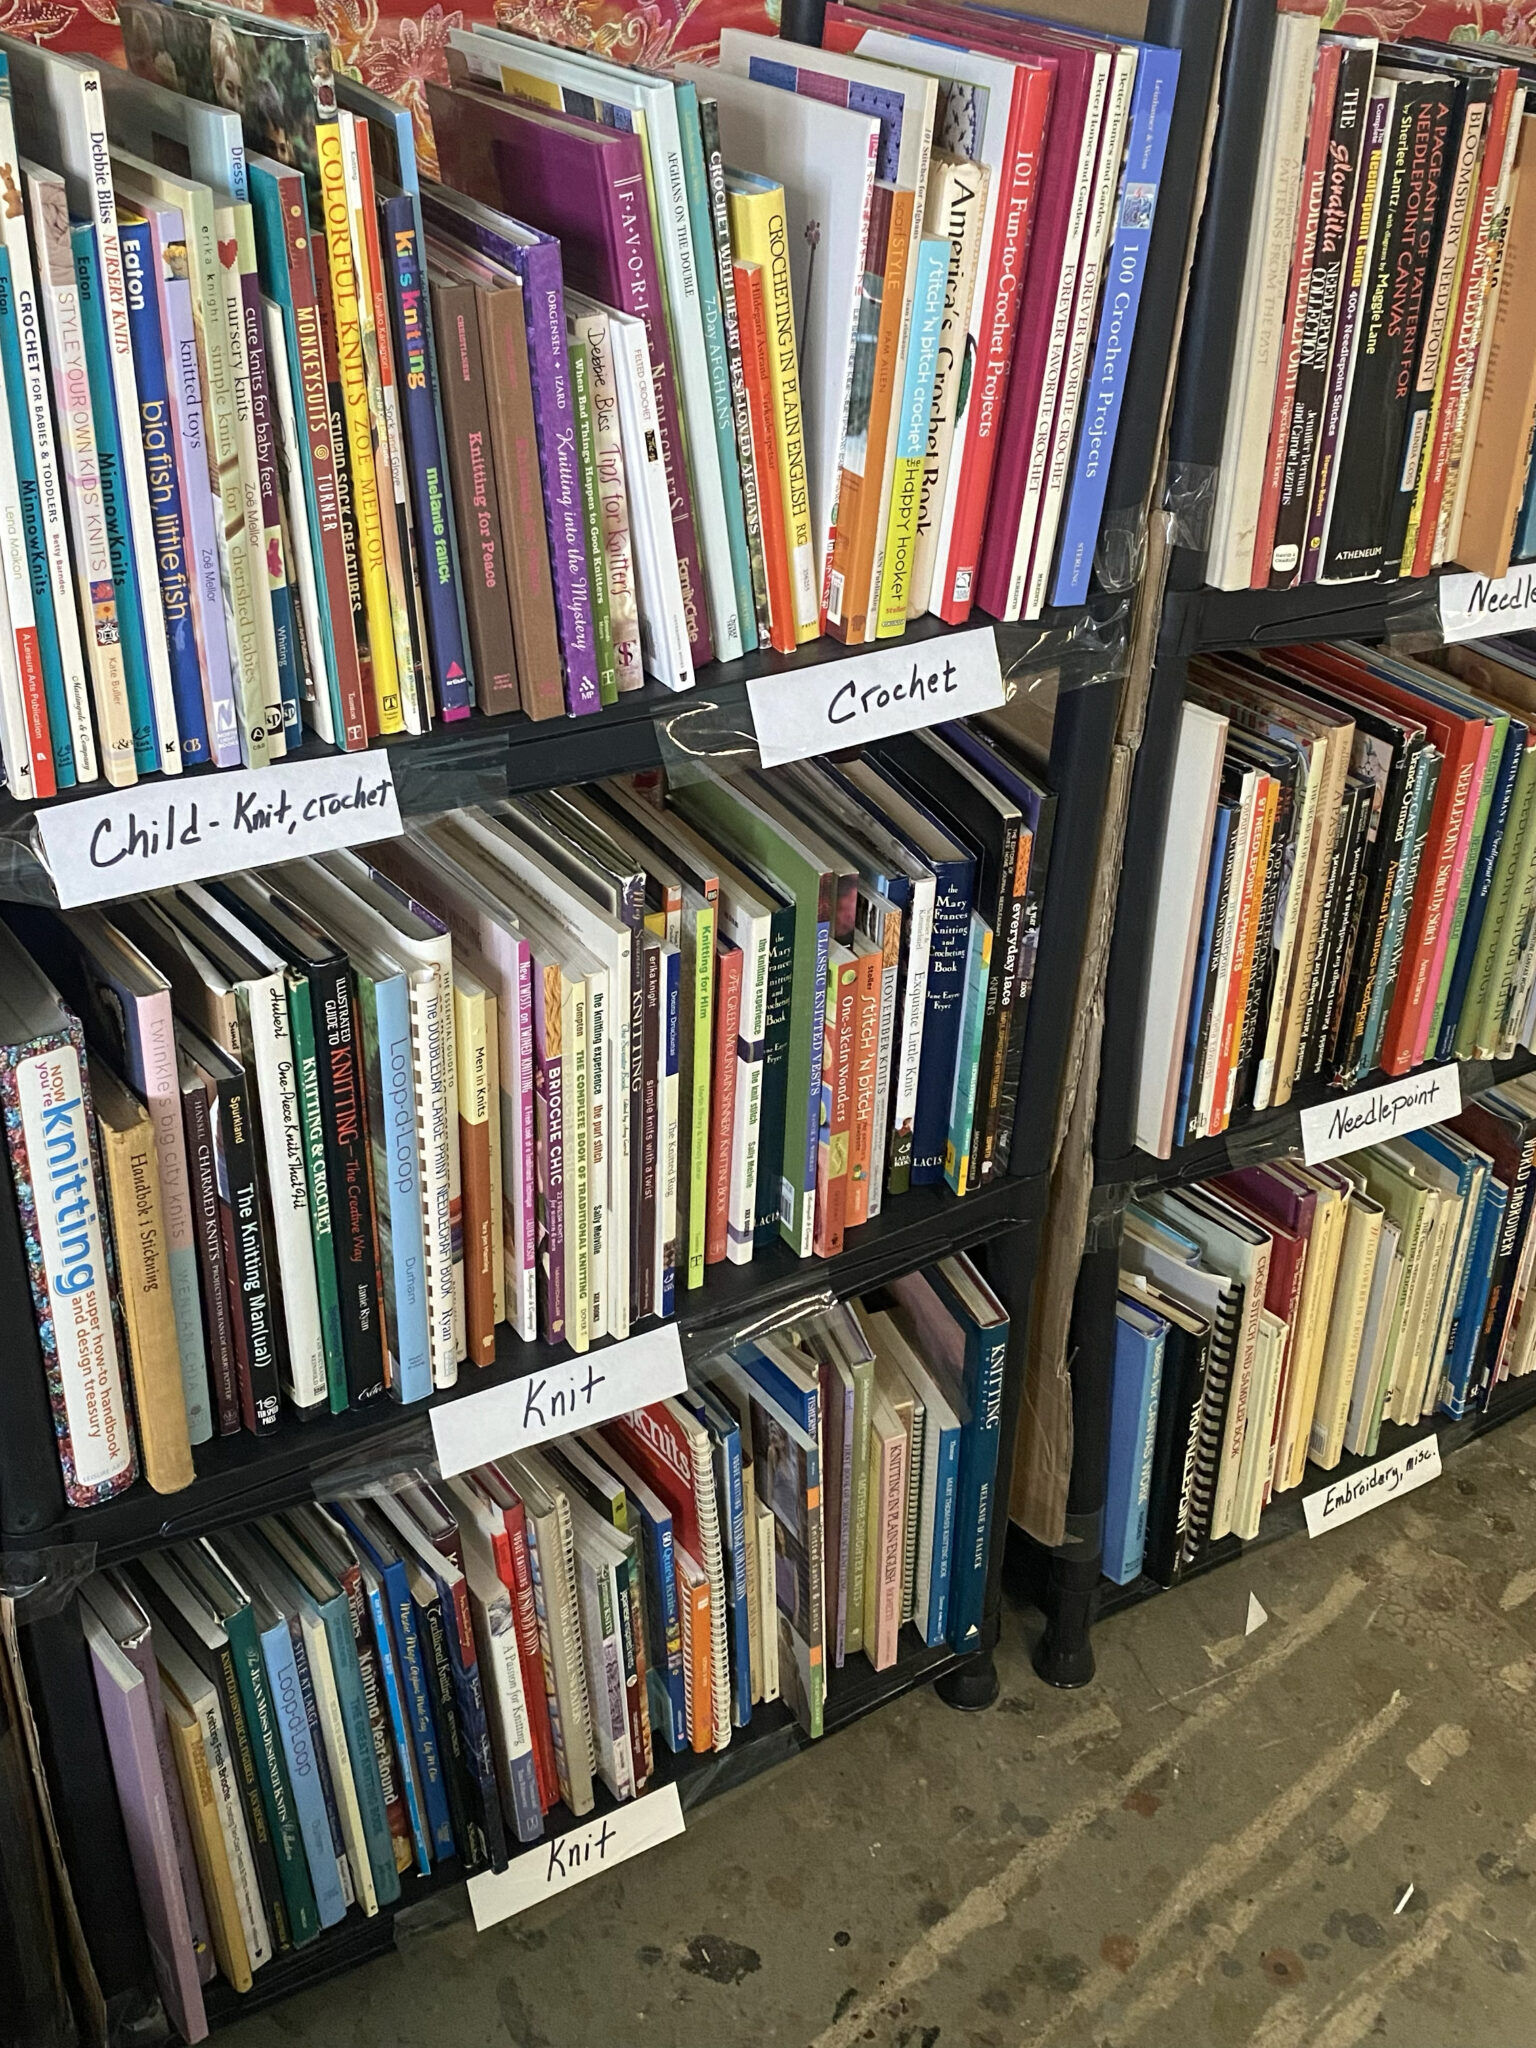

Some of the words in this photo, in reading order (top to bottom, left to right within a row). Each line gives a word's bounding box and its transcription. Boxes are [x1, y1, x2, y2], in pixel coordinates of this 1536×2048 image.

[1340, 88, 1359, 129] THE
[1436, 102, 1449, 119] A
[90, 131, 108, 185] Debbie
[230, 147, 243, 189] Dress
[1012, 150, 1035, 188] 101
[1402, 104, 1434, 248] NEEDLEPOINT
[1423, 126, 1447, 224] PAGEANT
[1445, 111, 1482, 252] BLOOMSBURY
[97, 189, 112, 225] Bliss
[1322, 140, 1354, 253] Glorafilia
[1359, 150, 1381, 240] Needlepoint
[102, 234, 125, 310] NURSERY
[989, 196, 1030, 354] Fun-to-Crochet
[1118, 243, 1140, 285] 100
[1352, 245, 1368, 287] Guide
[1416, 230, 1430, 261] OF
[77, 256, 92, 301] Eaton
[120, 239, 146, 312] Eaton
[768, 214, 793, 345] CROCHETING
[1053, 264, 1075, 339] FOREVER
[1075, 261, 1097, 337] FOREVER
[1371, 273, 1391, 325] Maggie
[1386, 254, 1413, 338] CANVAS
[58, 291, 78, 352] STYLE
[111, 310, 130, 355] KNITS
[226, 297, 242, 371] nursery
[244, 307, 258, 343] cute
[703, 295, 717, 342] 7-Day
[1101, 289, 1131, 385] Crochet
[1300, 267, 1327, 367] COLLECTION
[1313, 261, 1341, 373] NEEDLEPOINT
[1403, 267, 1427, 354] PATTERN
[1421, 257, 1456, 386] NEEDLEPOINT
[249, 347, 265, 391] knits
[321, 136, 353, 308] COLORFUL
[340, 319, 367, 407] KNITS
[360, 477, 384, 573] MELLOR
[586, 327, 607, 387] Debbie
[780, 349, 796, 373] IN
[1366, 326, 1379, 357] Lane
[65, 352, 88, 408] YOUR
[179, 336, 204, 407] knitted
[233, 374, 249, 422] knits
[708, 344, 731, 431] AFGHANS
[978, 360, 1007, 441] Projects
[1040, 343, 1063, 418] FAVORITE
[1063, 341, 1085, 416] FAVORITE
[1394, 358, 1413, 400] FOR
[72, 411, 91, 453] OWN
[188, 410, 204, 450] toys
[254, 393, 269, 420] for
[297, 307, 328, 433] MONKEYSUITS
[317, 474, 339, 533] TURNER
[594, 396, 615, 433] Bliss
[783, 378, 803, 437] PLAIN
[1085, 390, 1115, 478] Projects
[256, 422, 275, 463] baby
[468, 431, 487, 507] Knitting
[599, 443, 624, 485] Tips
[907, 457, 921, 469] the
[1028, 420, 1050, 492] CROCHET
[1050, 418, 1072, 490] CROCHET
[79, 456, 100, 505] KIDS'
[259, 460, 274, 498] feet
[426, 466, 444, 536] melanie
[604, 492, 625, 522] for
[788, 444, 810, 517] ENGLISH
[897, 469, 920, 532] Happy
[21, 479, 47, 597] MinnowKnits
[86, 513, 107, 576] KNITS
[97, 452, 127, 587] MinnowKnits
[476, 511, 491, 535] for
[201, 549, 213, 570] Zoë
[434, 538, 450, 585] falick
[482, 541, 497, 592] Peace
[891, 536, 913, 603] Hooker
[1335, 546, 1382, 561] ATHENEUM
[203, 571, 217, 604] Mellor
[276, 625, 288, 668] Whiting
[827, 660, 958, 724] Crochet
[90, 803, 201, 867] Child
[233, 790, 297, 835] Knit,
[303, 776, 393, 821] crochet
[1245, 815, 1265, 898] NEEDLEPOINT
[936, 896, 968, 912] Mary
[815, 929, 830, 983] CLASSIC
[1234, 900, 1252, 973] ALPHABETS
[934, 962, 958, 973] Book
[335, 976, 352, 1047] ILLUSTRATED
[813, 984, 828, 1049] KNITTED
[840, 994, 855, 1062] One-Skein
[35, 1062, 53, 1107] you're
[51, 1065, 67, 1103] NOW
[302, 1056, 323, 1144] KNITTING
[331, 1046, 359, 1147] KNITTING
[810, 1052, 824, 1097] VESTS
[837, 1063, 851, 1127] Wonders
[230, 1096, 246, 1148] Spurkland
[547, 1066, 563, 1144] BRIOCHE
[1328, 1080, 1440, 1140] Needlepoint
[197, 1144, 217, 1220] CHARMED
[310, 1147, 324, 1160] &
[549, 1147, 564, 1191] CHIC
[913, 1156, 943, 1168] LACIS
[43, 1097, 98, 1297] knitting
[237, 1182, 255, 1222] The
[312, 1161, 332, 1238] CROCHET
[349, 1184, 364, 1234] Creative
[1499, 1183, 1531, 1259] EMBROIDERY
[205, 1223, 221, 1266] KNITS
[242, 1224, 264, 1296] Knitting
[351, 1235, 369, 1263] Way
[85, 1289, 101, 1332] super
[403, 1257, 418, 1306] Durham
[71, 1296, 88, 1329] and
[249, 1294, 273, 1369] Man(ual)
[441, 1308, 454, 1343] Ryan
[76, 1329, 94, 1378] design
[92, 1334, 108, 1386] how-to
[83, 1379, 103, 1438] treasury
[523, 1364, 606, 1428] Knit
[986, 1342, 1006, 1430] KNITTING
[100, 1386, 121, 1461] handbook
[250, 1668, 266, 1699] JEAN
[294, 1640, 308, 1676] STYLE
[301, 1678, 311, 1692] AT
[257, 1701, 271, 1732] MOSS
[304, 1694, 319, 1729] LARGE
[359, 1650, 380, 1718] Knitting
[371, 1719, 399, 1806] Year-Round
[263, 1731, 283, 1790] DESIGNER
[273, 1790, 287, 1823] KNITS
[547, 1820, 616, 1882] Knit
